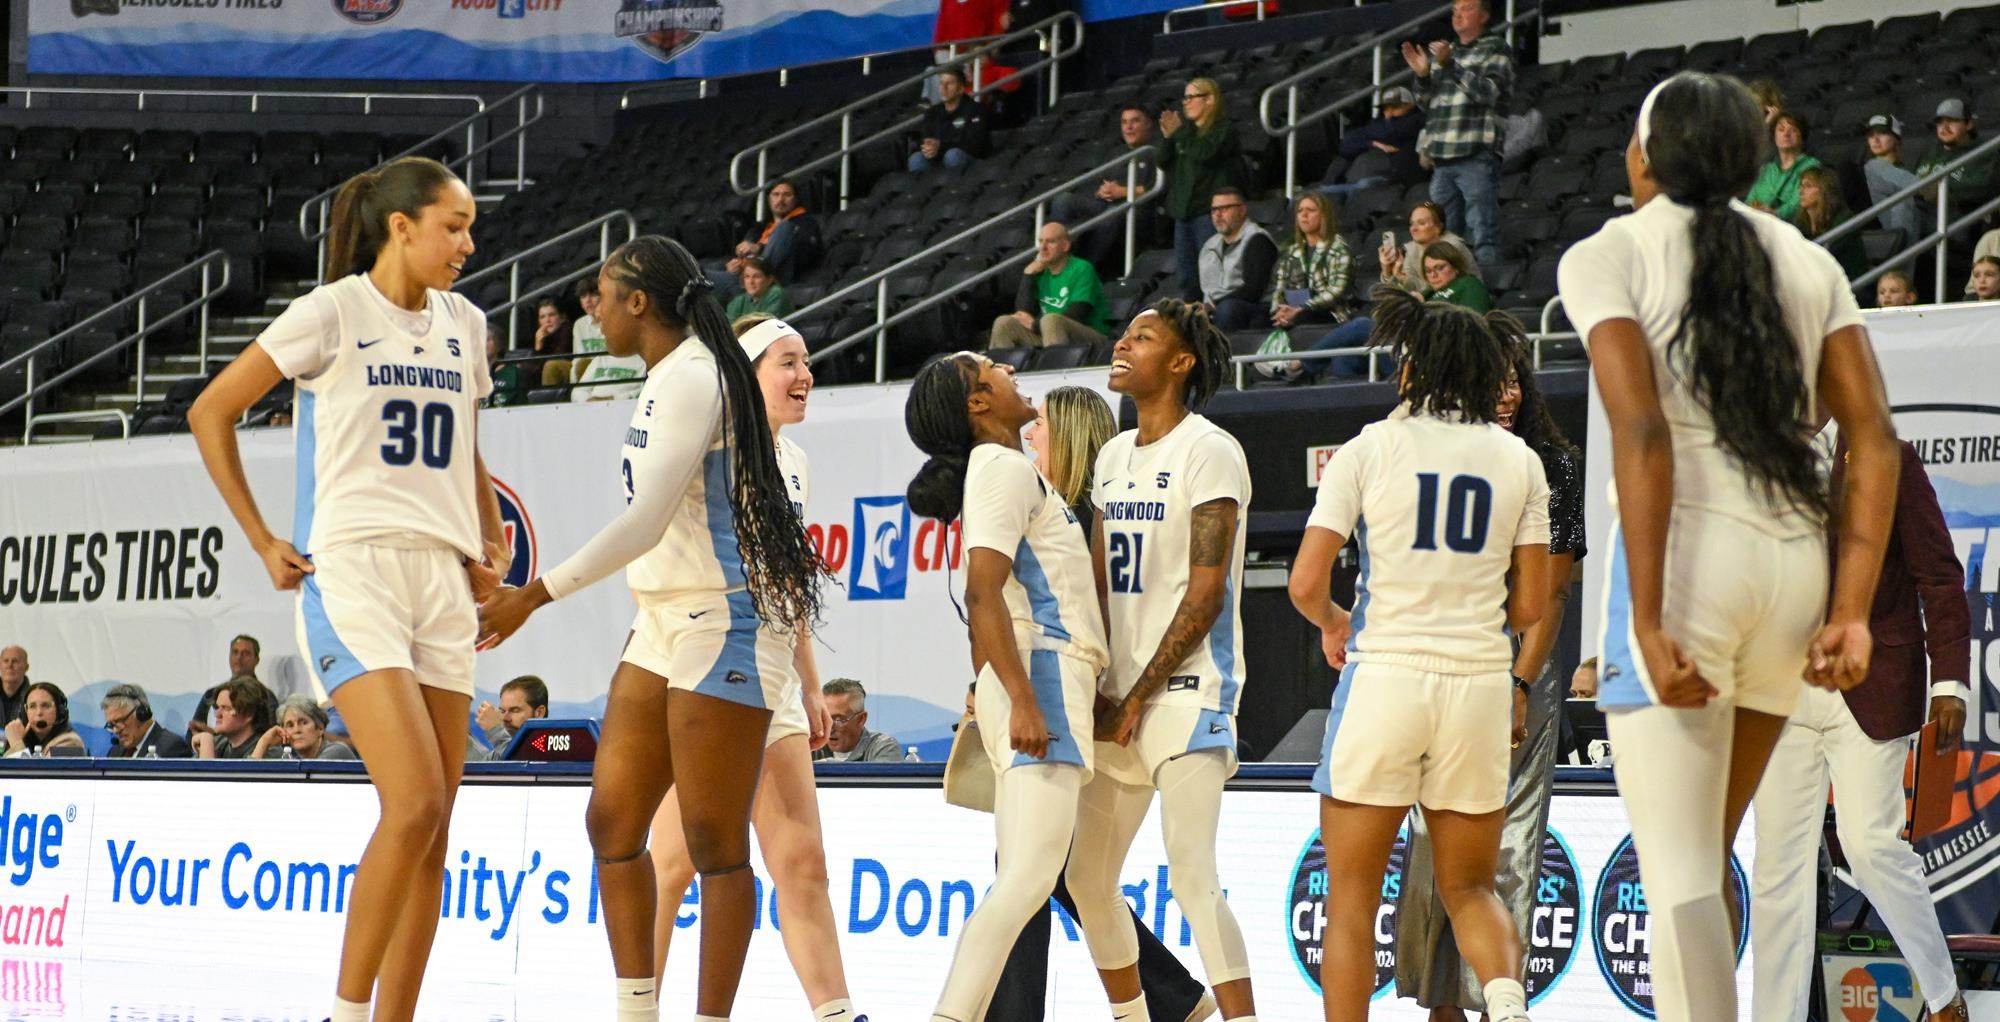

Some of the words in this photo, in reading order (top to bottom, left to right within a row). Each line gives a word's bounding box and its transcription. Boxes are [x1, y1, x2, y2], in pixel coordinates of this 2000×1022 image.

[366, 364, 462, 393] LONGWOOD
[380, 398, 455, 470] 30
[1411, 472, 1492, 555] 10
[115, 526, 223, 601] TIRES
[1109, 531, 1144, 595] 21
[547, 735, 570, 751] POSS
[106, 839, 211, 906] Your
[1612, 959, 1636, 974] THE
[1840, 985, 1878, 1009] BIG
